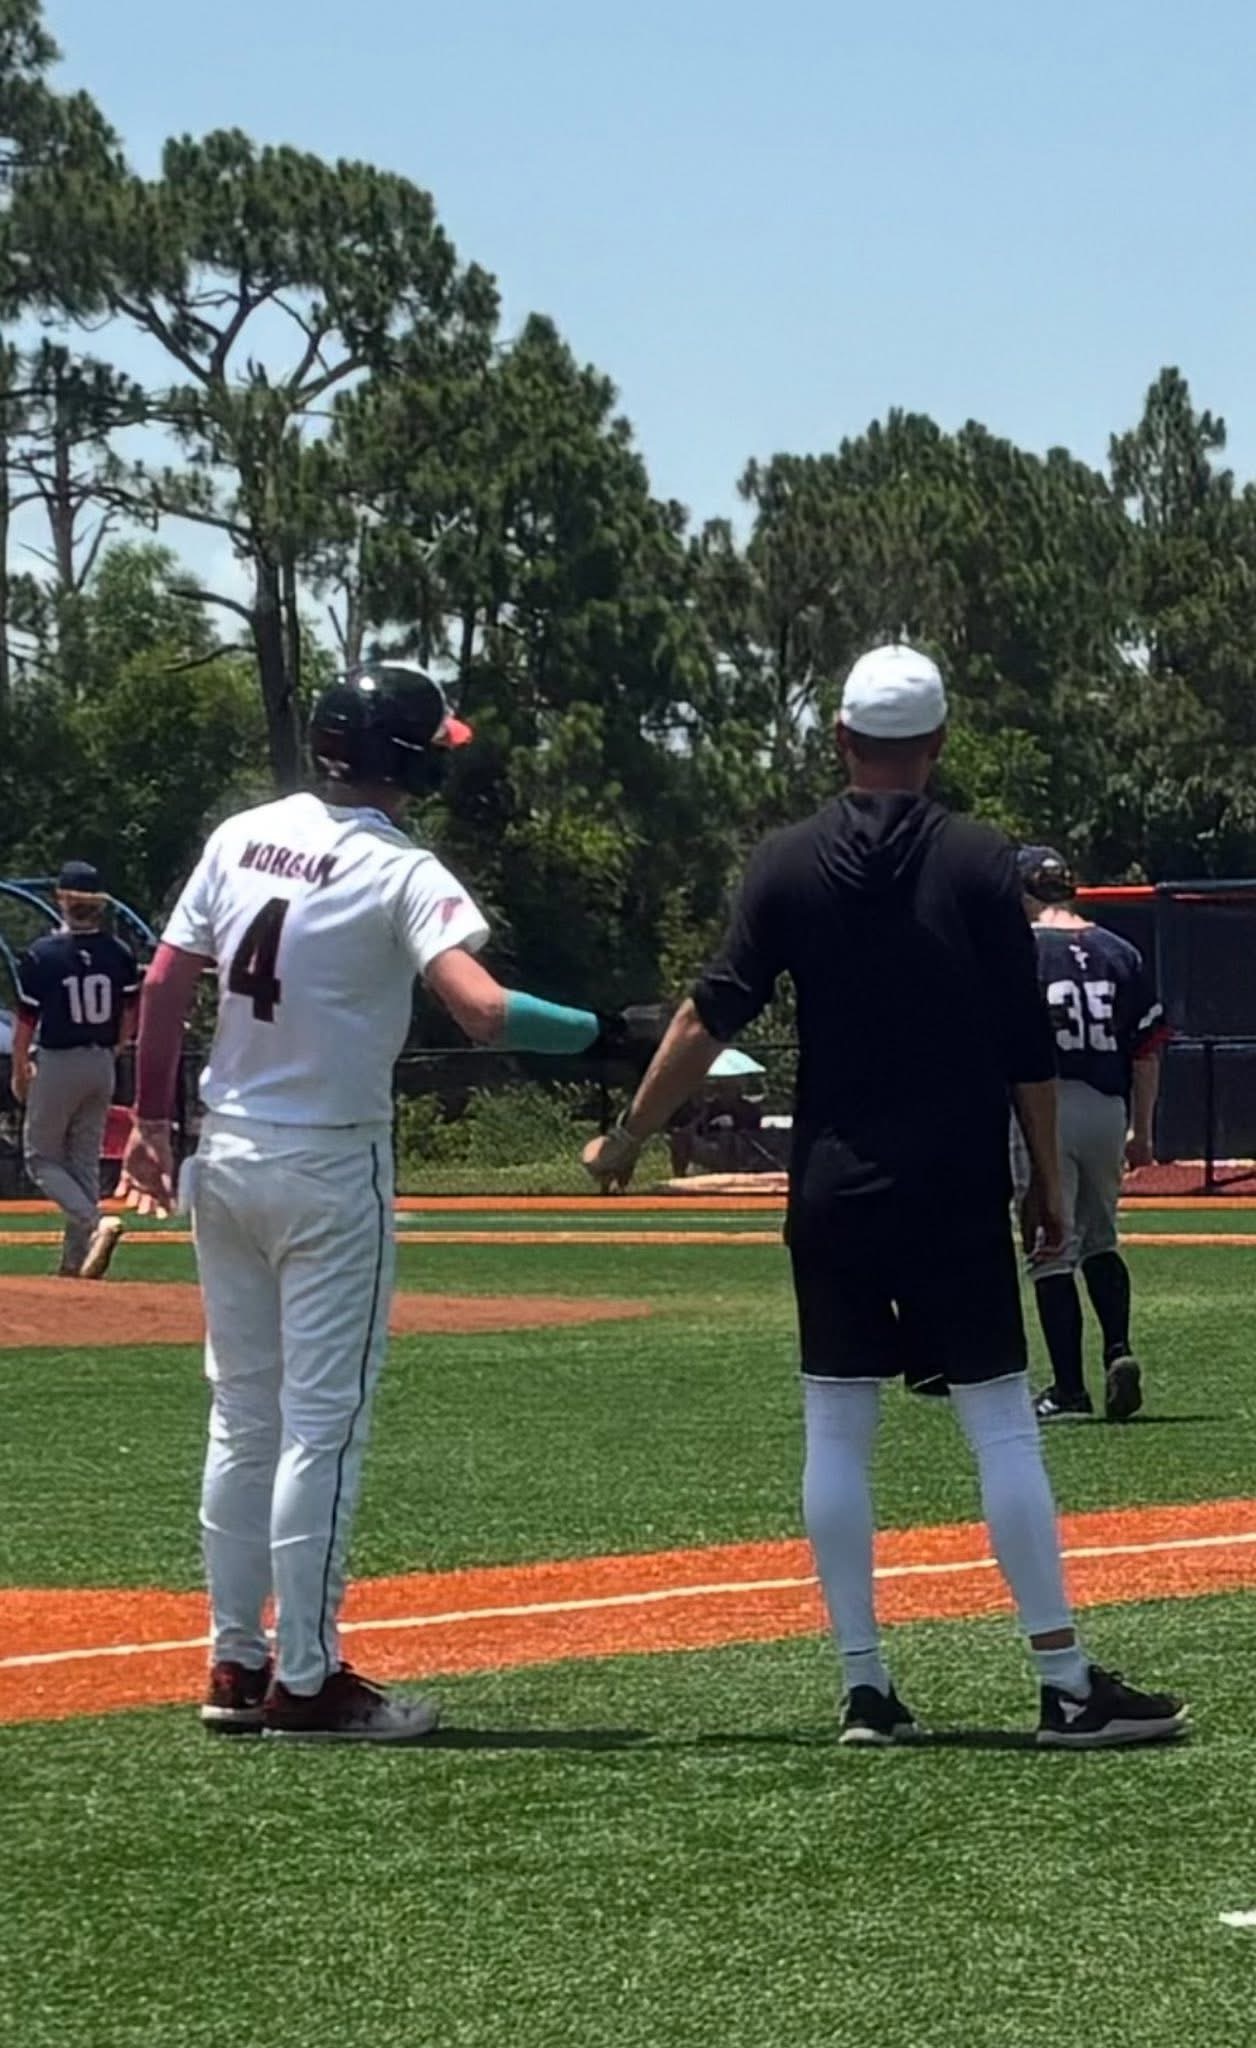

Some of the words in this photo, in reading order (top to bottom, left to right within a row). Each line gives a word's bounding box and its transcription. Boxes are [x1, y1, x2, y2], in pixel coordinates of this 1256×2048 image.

[229, 897, 290, 1023] 4
[62, 974, 112, 1024] 10
[1047, 979, 1117, 1051] 35
